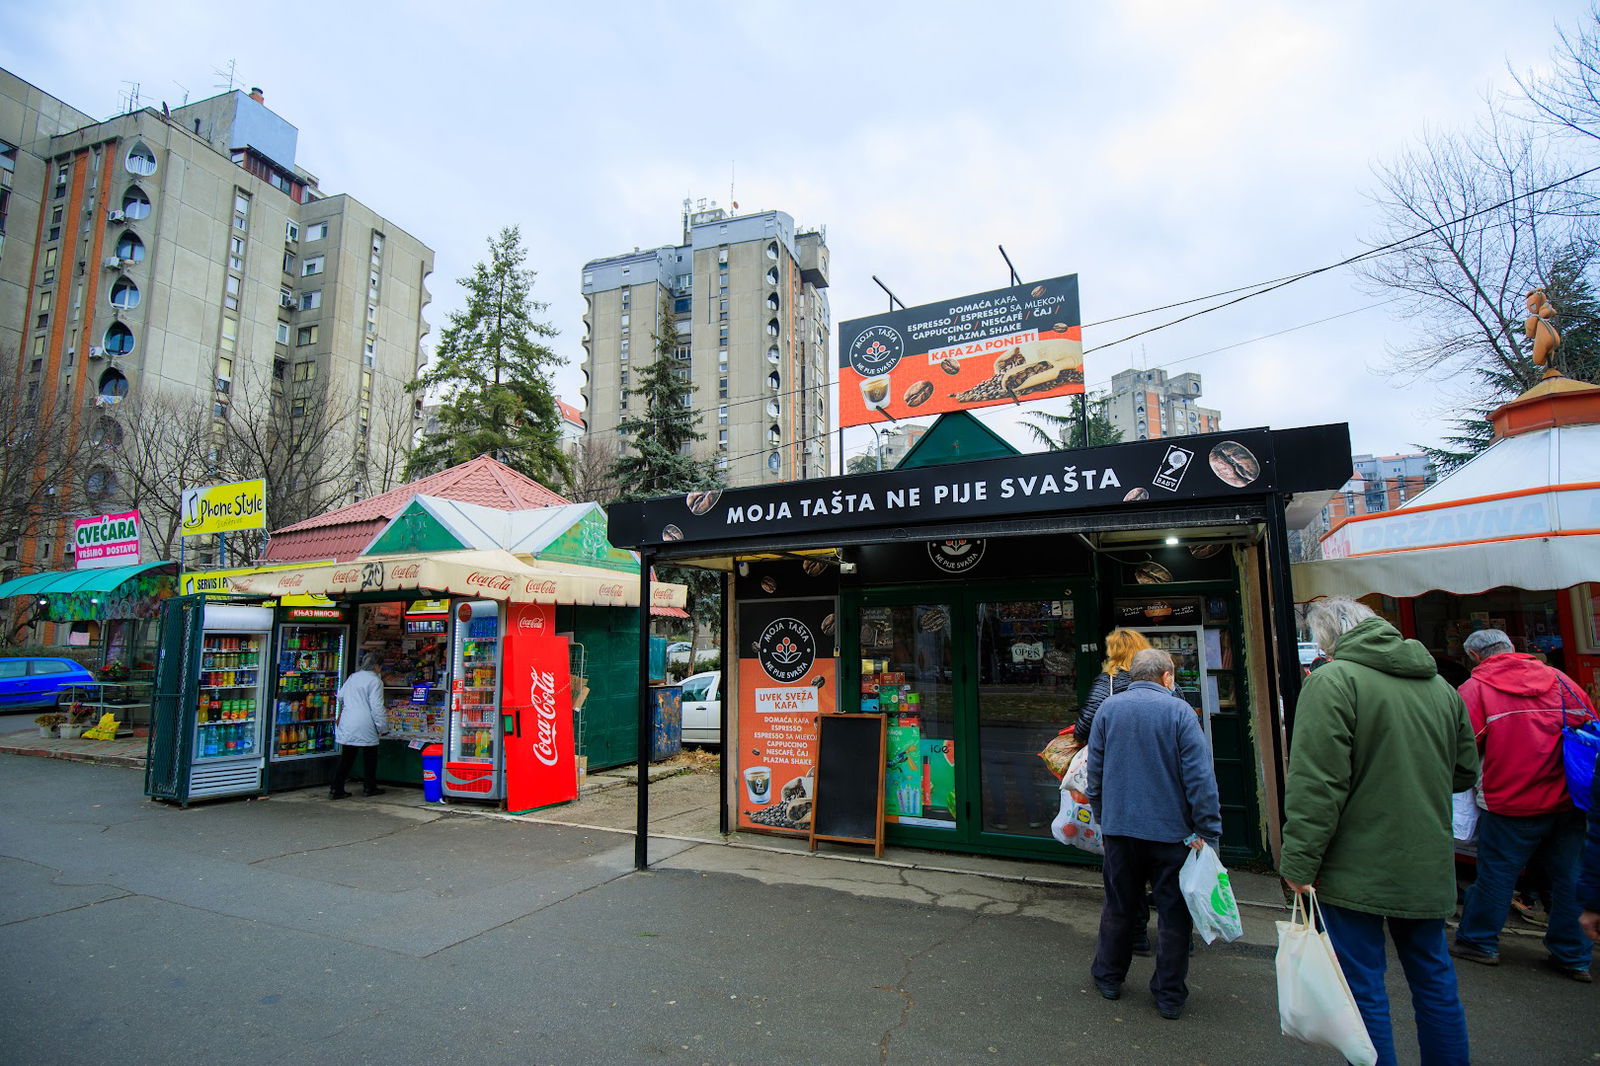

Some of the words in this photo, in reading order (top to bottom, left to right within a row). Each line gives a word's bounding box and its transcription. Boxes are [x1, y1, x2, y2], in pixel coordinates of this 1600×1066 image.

[907, 318, 951, 332] ESPRESSO
[960, 307, 1007, 322] ESPRESSO
[1010, 304, 1022, 312] SA
[1024, 295, 1065, 309] MLEKOM
[949, 300, 992, 315] DOMAĆA
[994, 295, 1018, 306] KAFA
[912, 324, 972, 340] CAPPUCCINO
[981, 311, 1023, 327] NESCAFÉ
[1033, 307, 1052, 318] ČAJ
[947, 331, 987, 343] PLAZMA
[989, 323, 1022, 335] SHAKE
[855, 330, 875, 349] MOJA
[878, 329, 897, 343] TAŠTA
[931, 347, 963, 361] KAFA
[965, 343, 983, 353] ZA
[985, 332, 1035, 350] PONETI
[857, 362, 865, 371] NE
[863, 367, 876, 375] PIJE
[876, 358, 897, 374] SVAŠTA
[726, 501, 792, 524] MOJA
[801, 490, 875, 517] TAŠTA
[886, 487, 921, 509] NE
[934, 481, 987, 504] PIJE
[1000, 465, 1121, 499] SVAŠTA
[201, 499, 232, 520] Phone
[235, 492, 263, 517] Style
[77, 516, 137, 545] CVEĆARA
[78, 547, 103, 558] VRŠIMO
[106, 543, 137, 555] DOSTAVU
[935, 554, 944, 563] NE
[943, 561, 956, 569] PIJE
[957, 553, 979, 569] SVAŠTA
[764, 622, 785, 643] MOJA
[788, 621, 811, 643] TAŠTA
[765, 660, 774, 672] NE
[772, 667, 786, 679] PIJE
[786, 661, 808, 679] SVAŠTA
[761, 693, 782, 702] UVEK
[785, 689, 814, 701] SVEŽA
[775, 701, 798, 709] KAFA
[754, 731, 784, 739] ESPRESSO
[767, 740, 808, 748] CAPPUCCINO
[763, 756, 789, 764] PLAZMA
[791, 757, 812, 765] SHAKE
[797, 749, 809, 757] ČAJ
